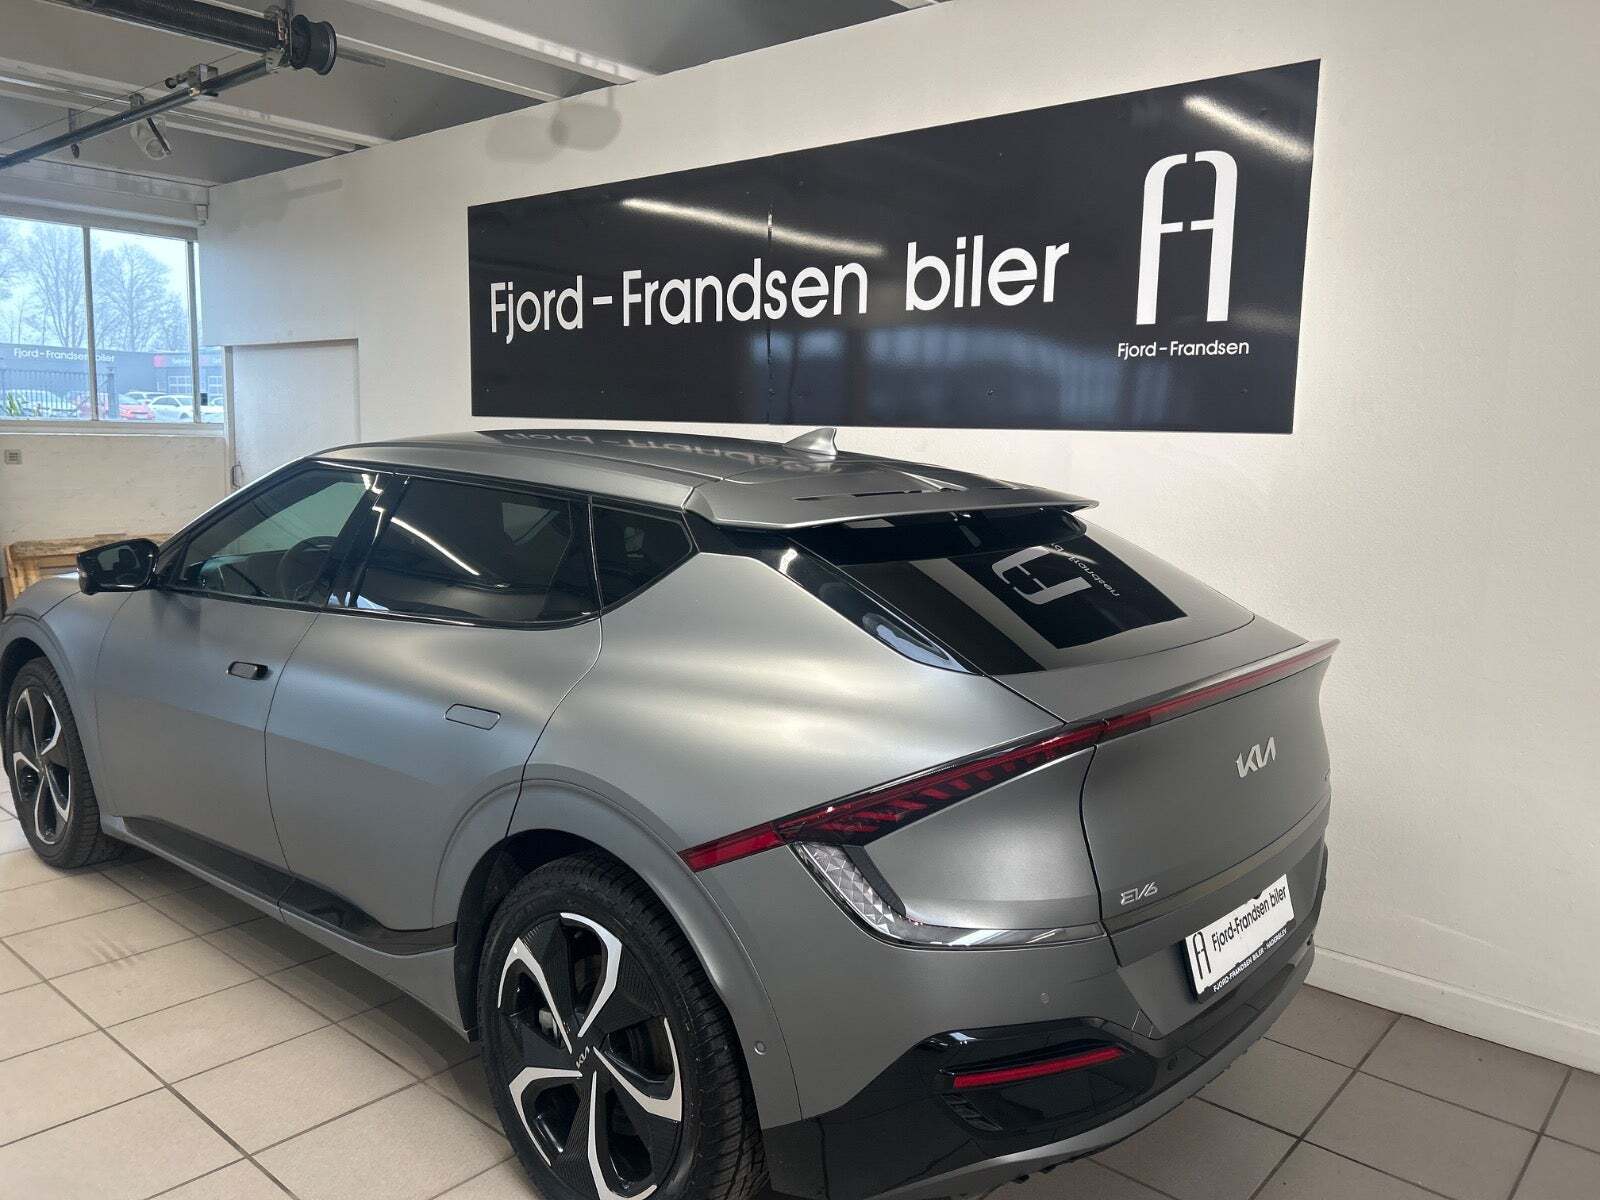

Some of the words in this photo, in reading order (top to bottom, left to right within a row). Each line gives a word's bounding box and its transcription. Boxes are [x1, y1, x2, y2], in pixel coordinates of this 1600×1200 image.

[490, 275, 583, 345] Fjord
[623, 257, 868, 327] Frandsen
[905, 234, 1070, 311] biler
[13, 347, 39, 359] Fjord
[1117, 341, 1157, 360] Fjord
[1170, 339, 1250, 357] Frandsen
[1235, 736, 1276, 778] KIA
[1120, 881, 1159, 906] EV6
[1268, 885, 1287, 907] biler
